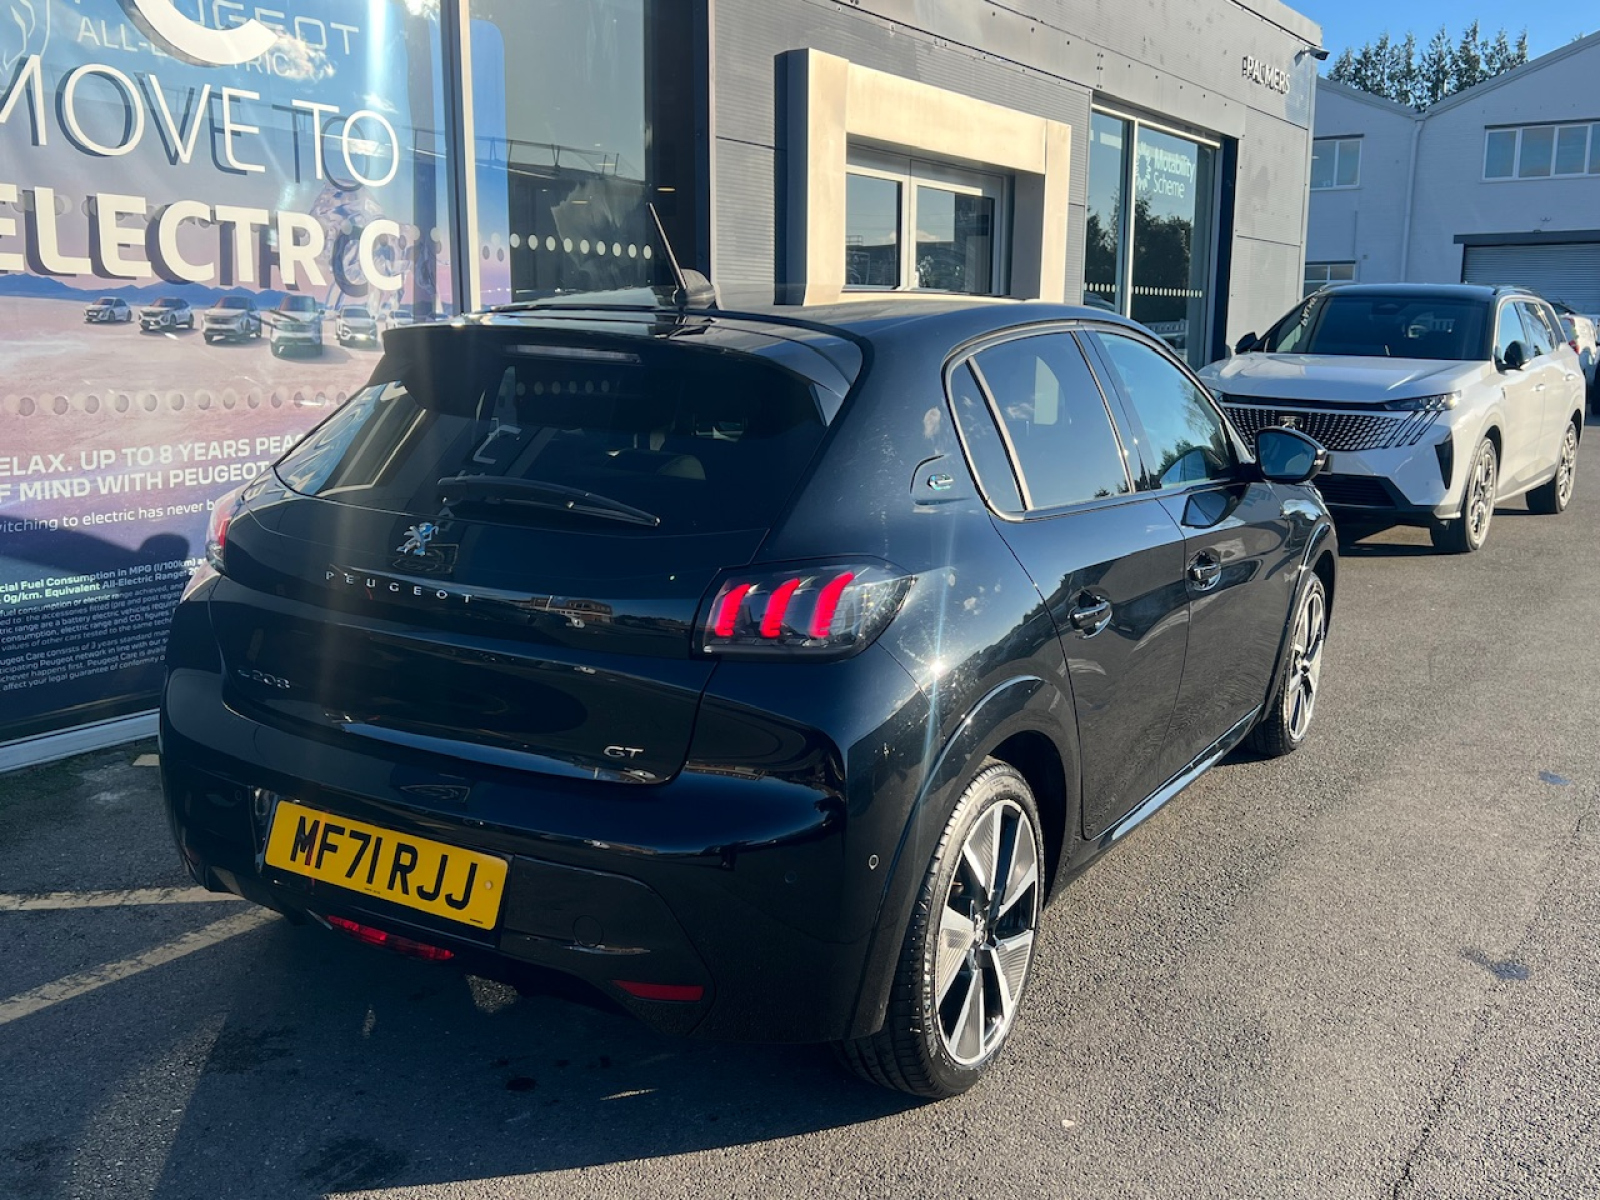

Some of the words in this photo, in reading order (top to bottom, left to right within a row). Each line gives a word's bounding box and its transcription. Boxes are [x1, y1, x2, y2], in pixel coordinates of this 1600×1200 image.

[1247, 55, 1290, 94] PALMERS
[292, 98, 400, 187] TO
[1154, 147, 1195, 184] Motability
[1154, 171, 1185, 199] Scheme
[80, 449, 116, 471] UP
[121, 446, 155, 467] TO
[159, 444, 173, 464] 8
[178, 438, 251, 462] YEARS
[19, 478, 91, 502] MIND
[96, 470, 162, 495] WITH
[169, 460, 270, 488] PEUGEOT
[62, 515, 79, 527] to
[82, 508, 136, 527] electric
[138, 505, 164, 519] has
[166, 502, 204, 516] never
[3, 591, 43, 604] 0g/km.
[45, 583, 100, 597] Equivalent
[101, 575, 153, 589] All-Electric
[155, 570, 187, 581] Range:
[20, 578, 45, 590] Fuel
[46, 570, 116, 587] Consumption
[117, 568, 127, 577] in
[129, 564, 152, 576] MPG
[325, 570, 472, 603] PEUGEOT
[14, 623, 39, 633] range
[40, 620, 54, 629] are
[61, 615, 91, 626] battery
[92, 610, 120, 621] electric
[120, 604, 151, 616] vehicles
[18, 600, 72, 616] consumption
[83, 594, 111, 605] electric
[41, 607, 88, 620] accessories
[60, 624, 90, 635] electric
[113, 616, 128, 626] and
[25, 651, 46, 661] Care
[97, 638, 119, 650] years
[119, 631, 152, 643] standard
[39, 655, 75, 668] Peugeot
[74, 648, 106, 661] network
[3, 680, 27, 692] affect
[28, 677, 48, 688] your
[48, 672, 68, 682] legal
[68, 665, 110, 681] guarantee
[30, 666, 67, 678] happens
[86, 655, 120, 668] Peugeot
[119, 651, 138, 661] Care
[603, 745, 645, 760] GT
[289, 815, 383, 885] MF71
[387, 841, 478, 911] RJJ
